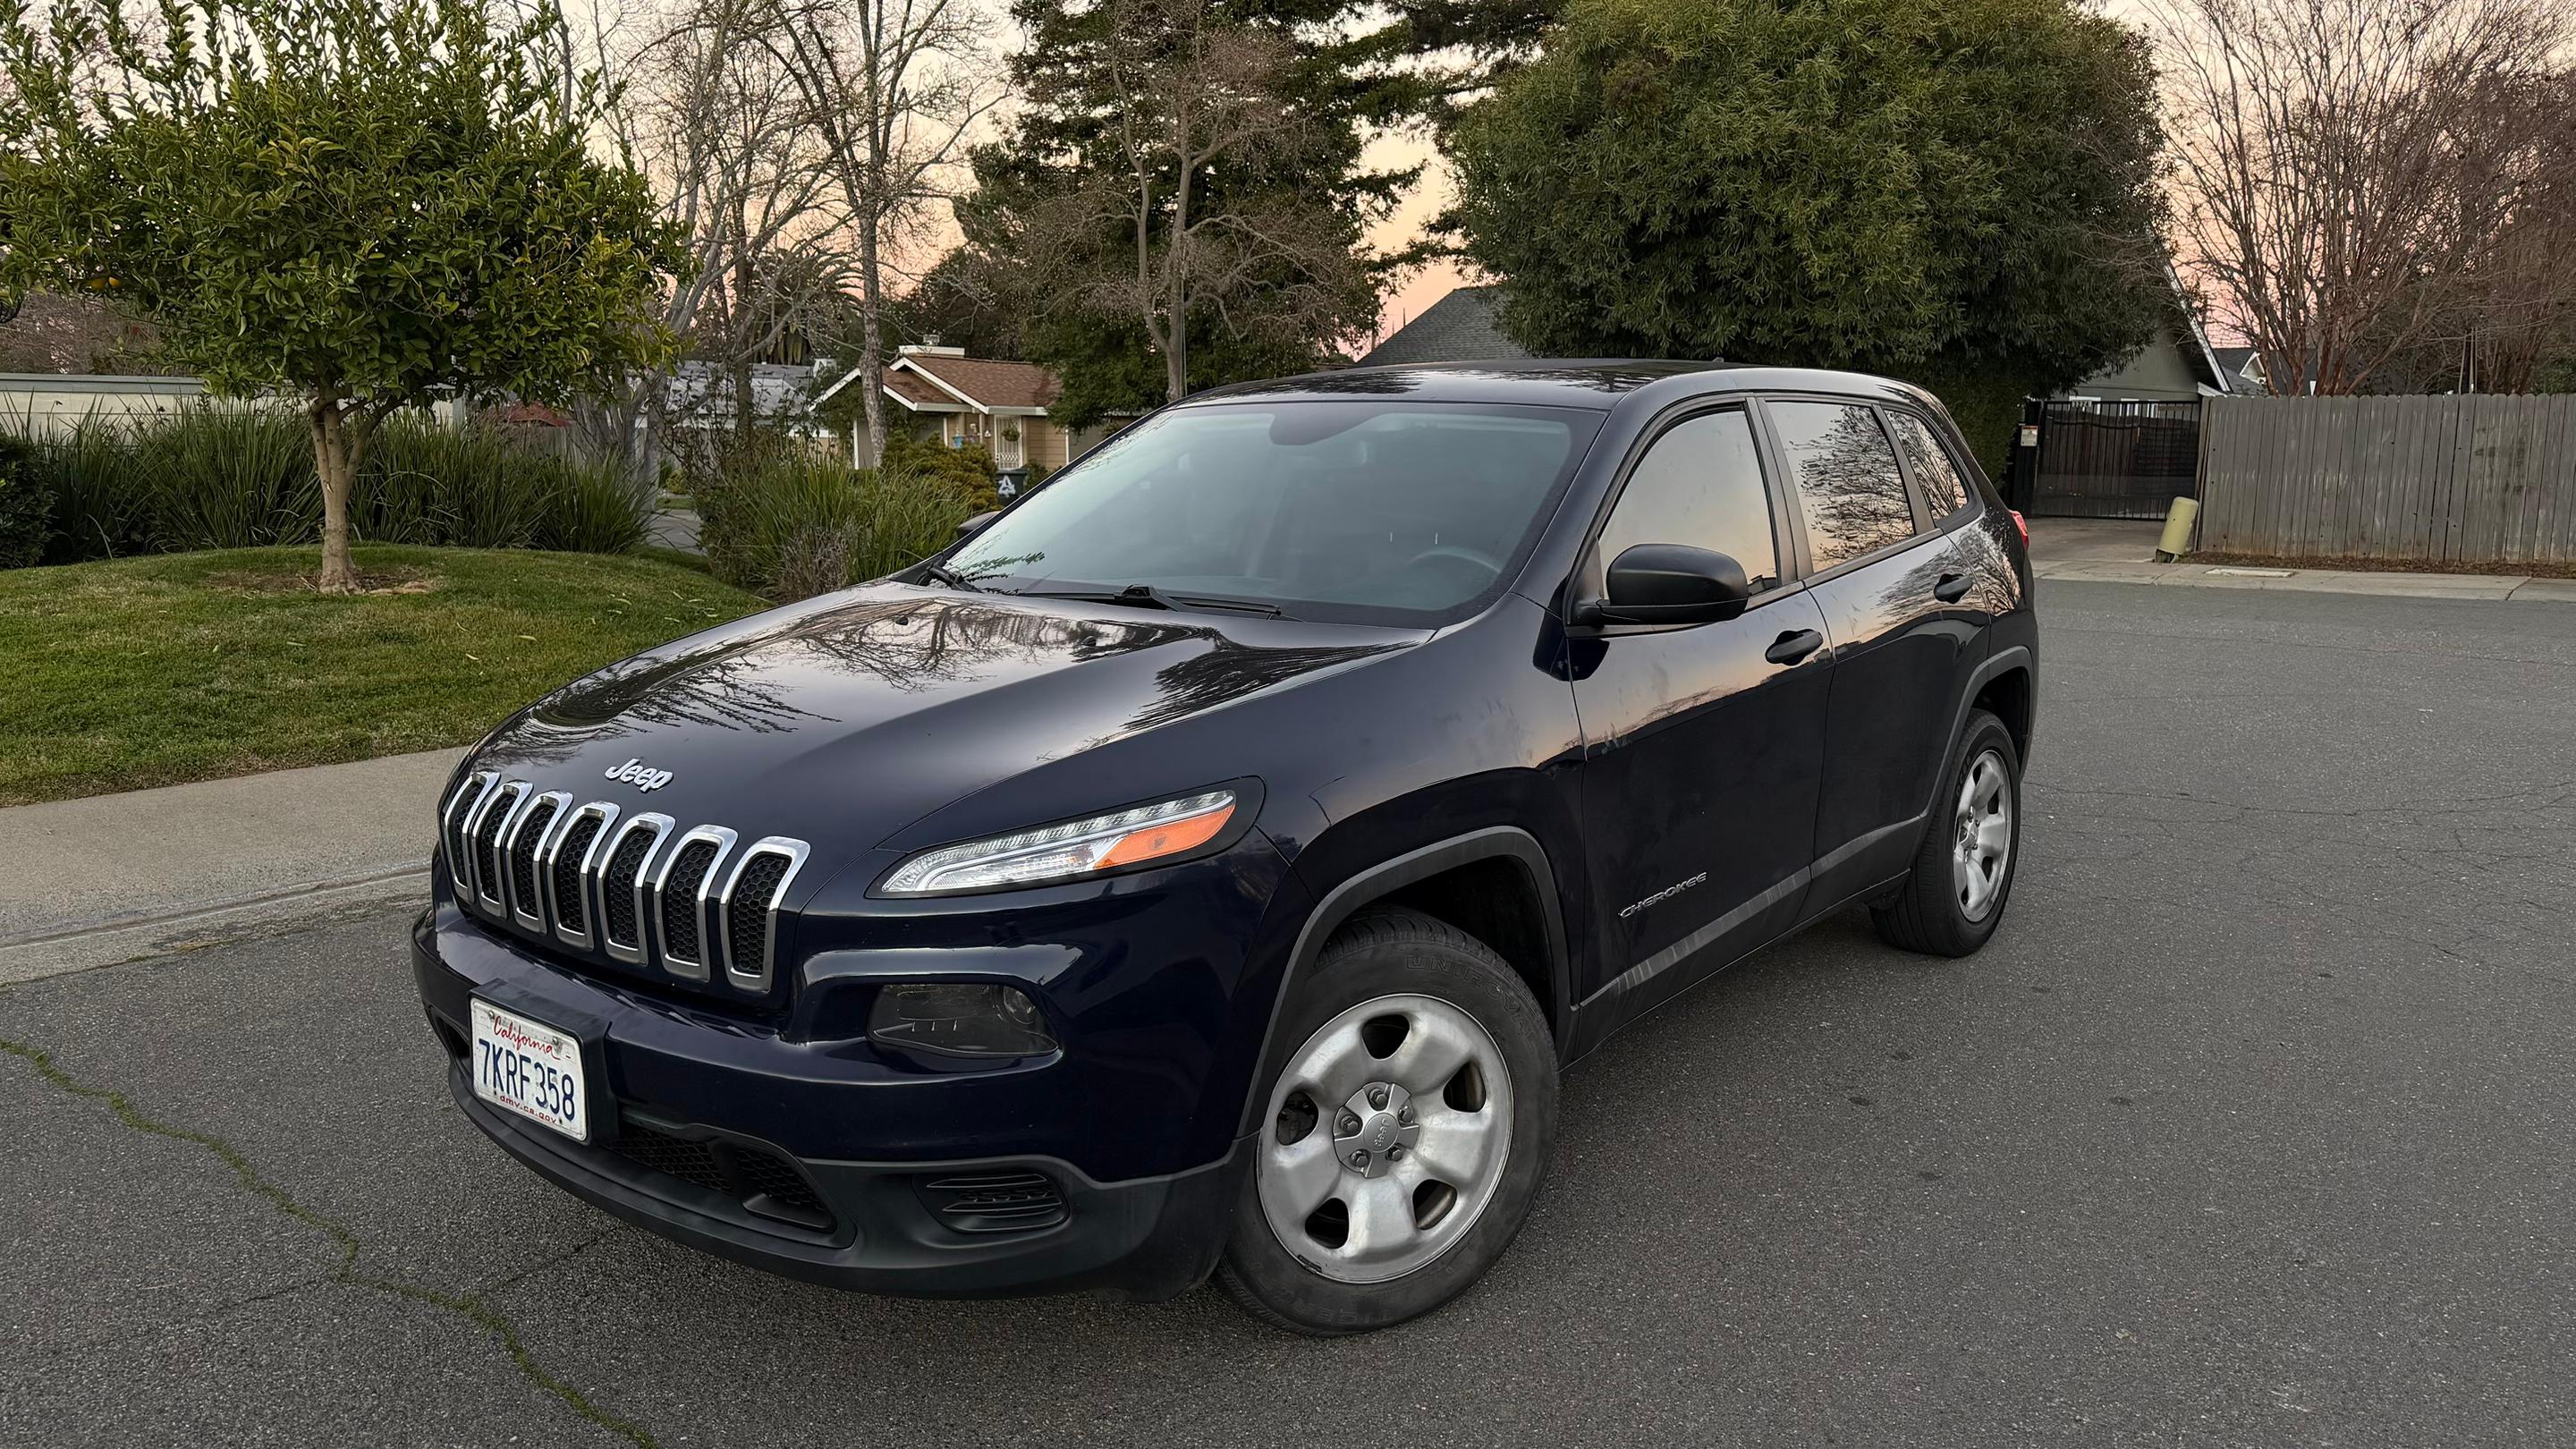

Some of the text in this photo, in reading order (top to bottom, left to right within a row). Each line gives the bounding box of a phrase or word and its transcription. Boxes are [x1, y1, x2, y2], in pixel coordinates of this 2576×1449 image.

[605, 758, 674, 793] Jeep
[1618, 871, 1707, 919] CHEROKEE
[1404, 954, 1538, 1053] UNIROYAL
[493, 1015, 561, 1060] California
[479, 1038, 575, 1122] 7KRF358
[499, 1094, 558, 1125] dmv.ca.gov
[1373, 1117, 1391, 1148] Jeep
